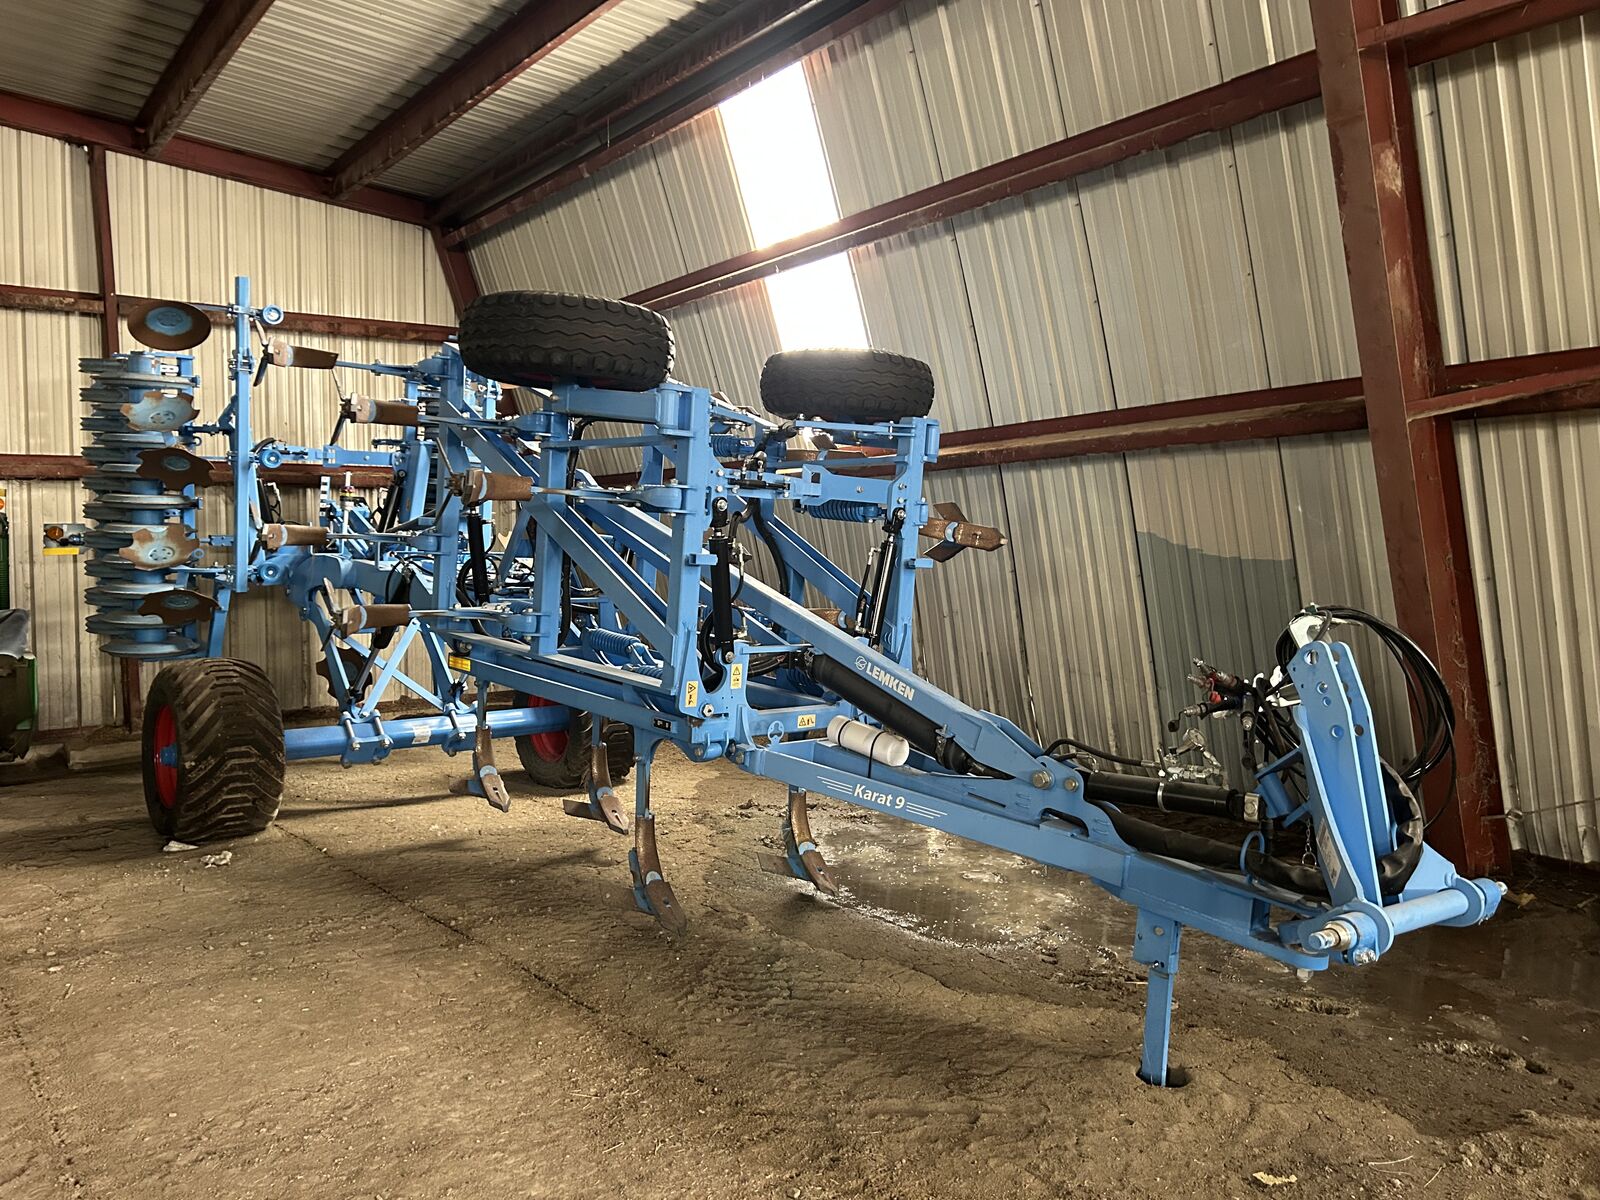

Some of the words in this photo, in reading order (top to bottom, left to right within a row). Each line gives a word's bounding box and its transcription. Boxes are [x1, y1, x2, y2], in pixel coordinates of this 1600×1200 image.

[866, 661, 915, 701] LEMKEN
[854, 784, 893, 807] Karat
[895, 796, 905, 809] 9
